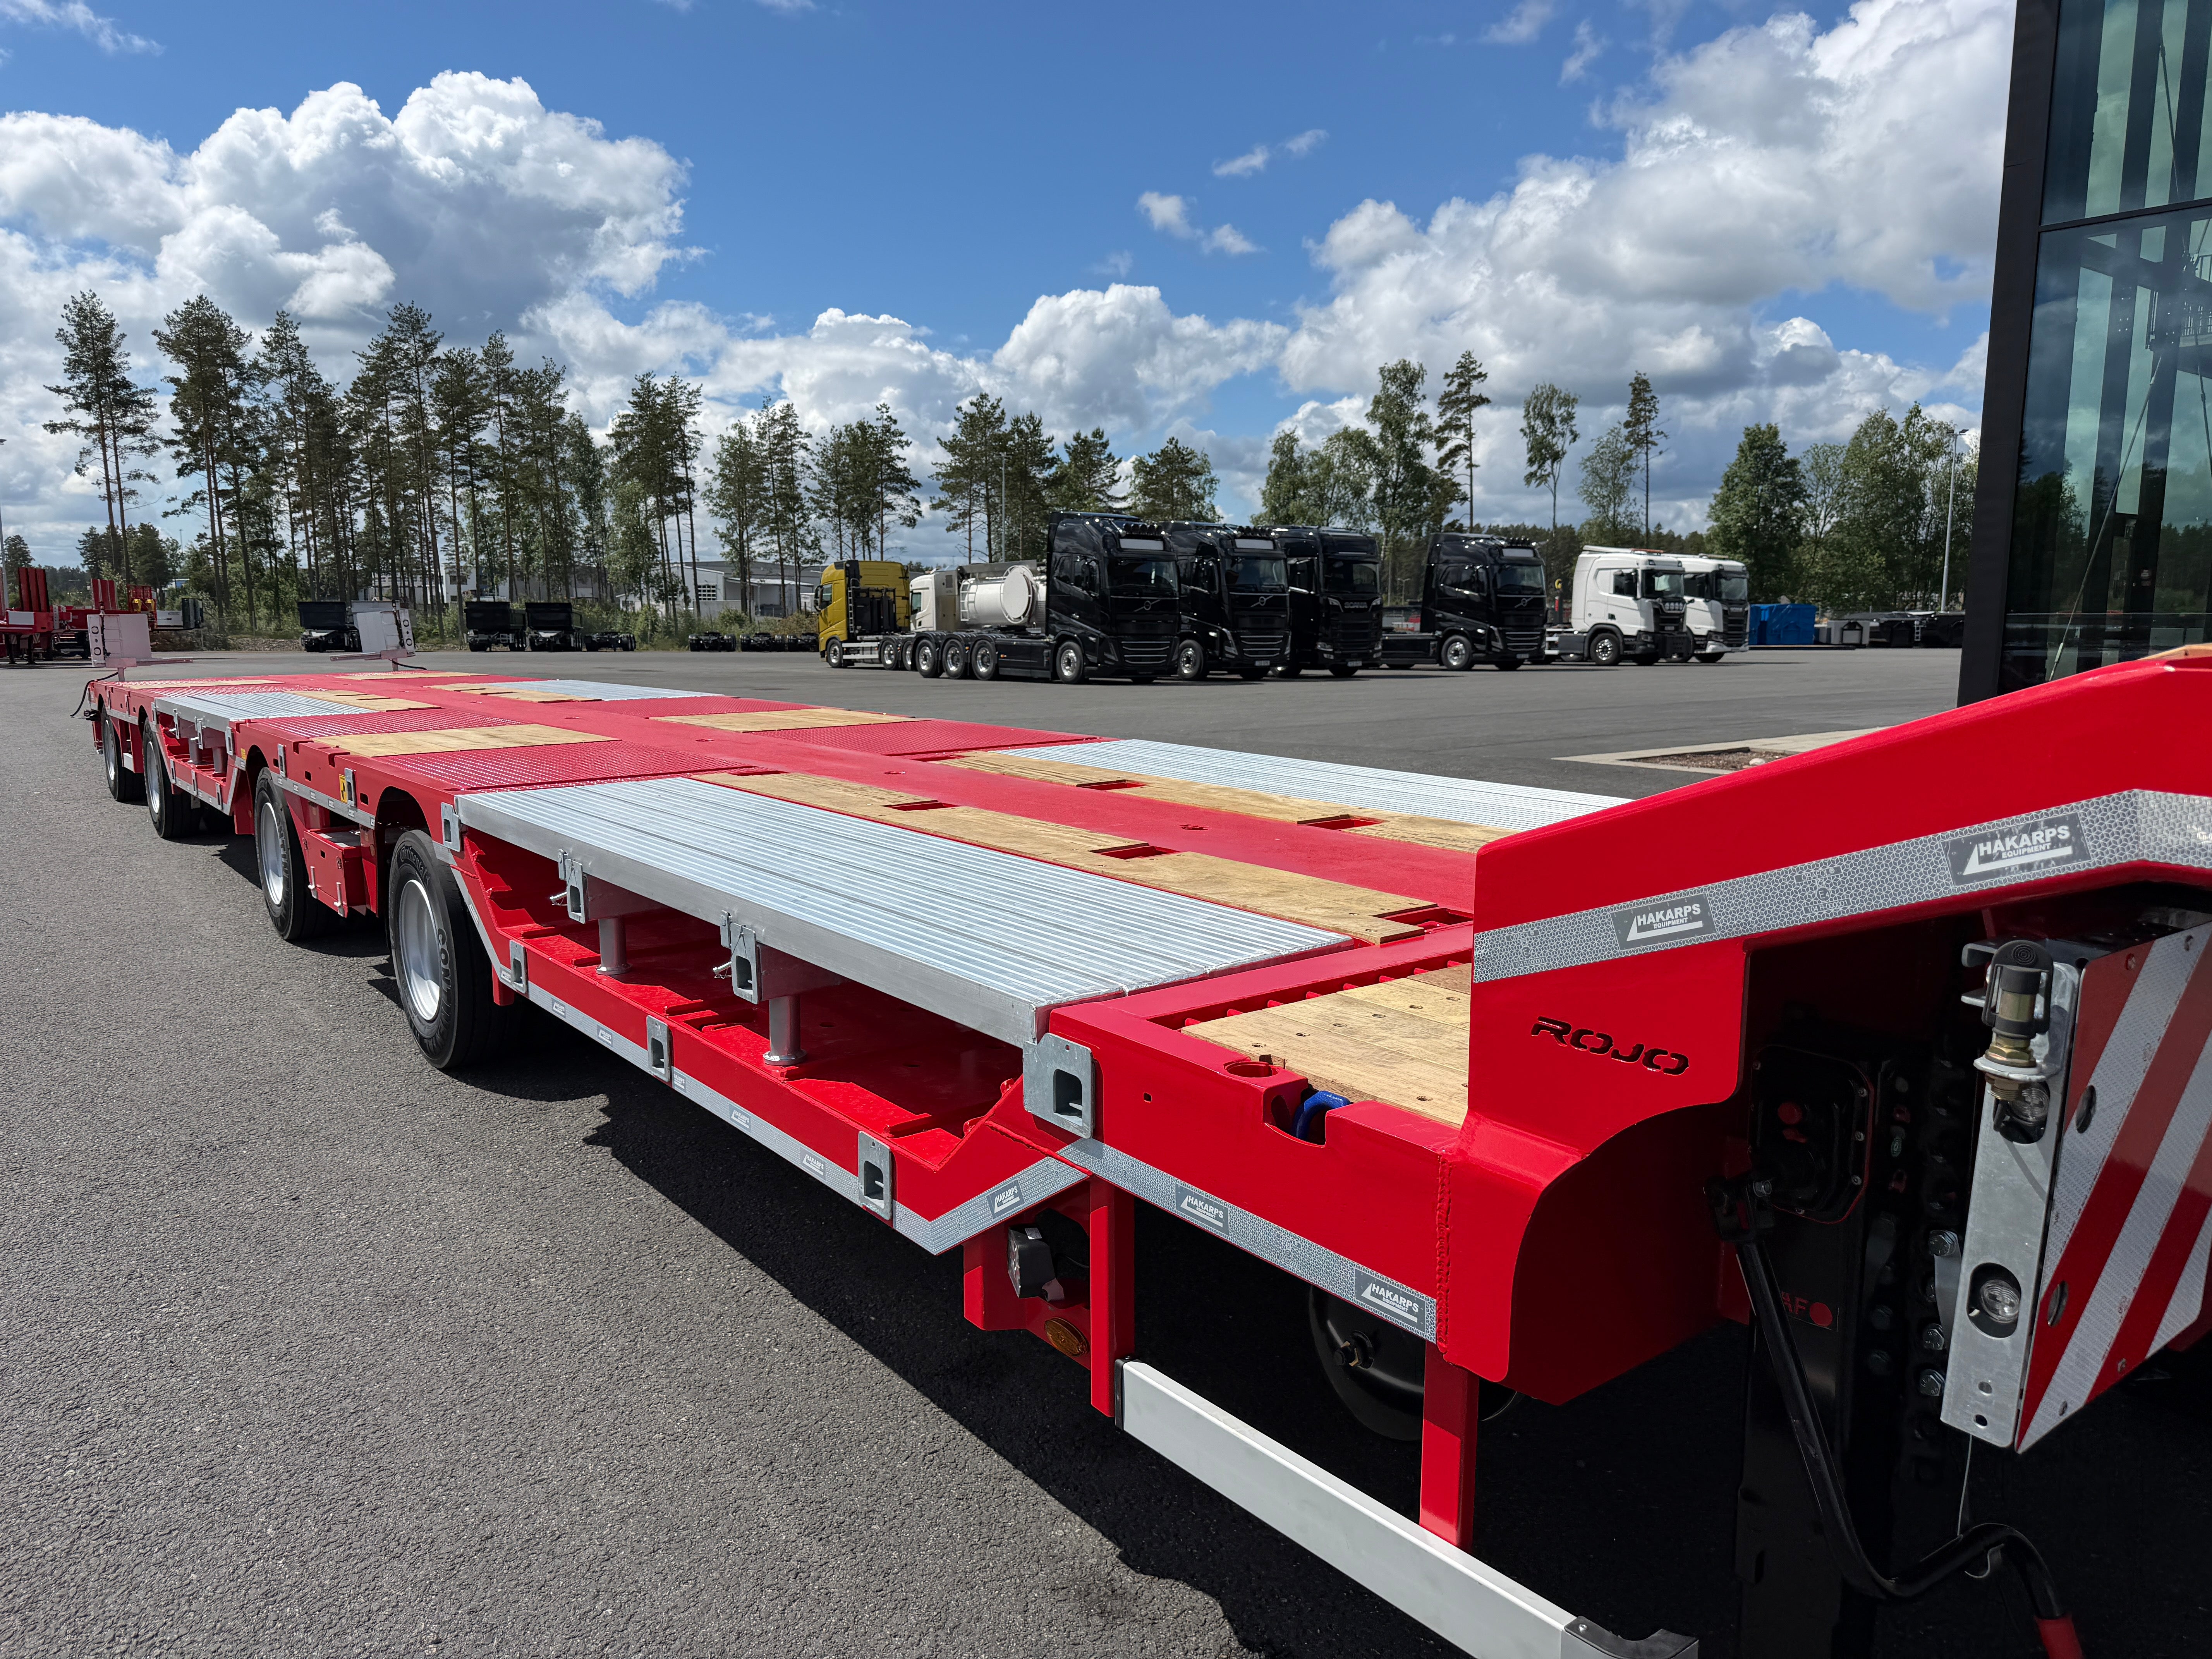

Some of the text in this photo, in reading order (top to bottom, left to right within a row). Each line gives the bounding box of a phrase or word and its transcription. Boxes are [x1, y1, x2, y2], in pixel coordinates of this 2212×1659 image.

[1979, 825, 2070, 856] HAKARPS
[2002, 843, 2051, 858] EQUIPMENT
[1802, 869, 1831, 881] ORAFOL
[1637, 904, 1701, 926] HAKARPS
[1654, 917, 1688, 929] EQUIPMENT
[1531, 1016, 1689, 1075] ROJO
[996, 1186, 1018, 1203] HAKARPS
[1188, 1195, 1224, 1218] HAKARPS
[1372, 1283, 1419, 1312] HAKARPS
